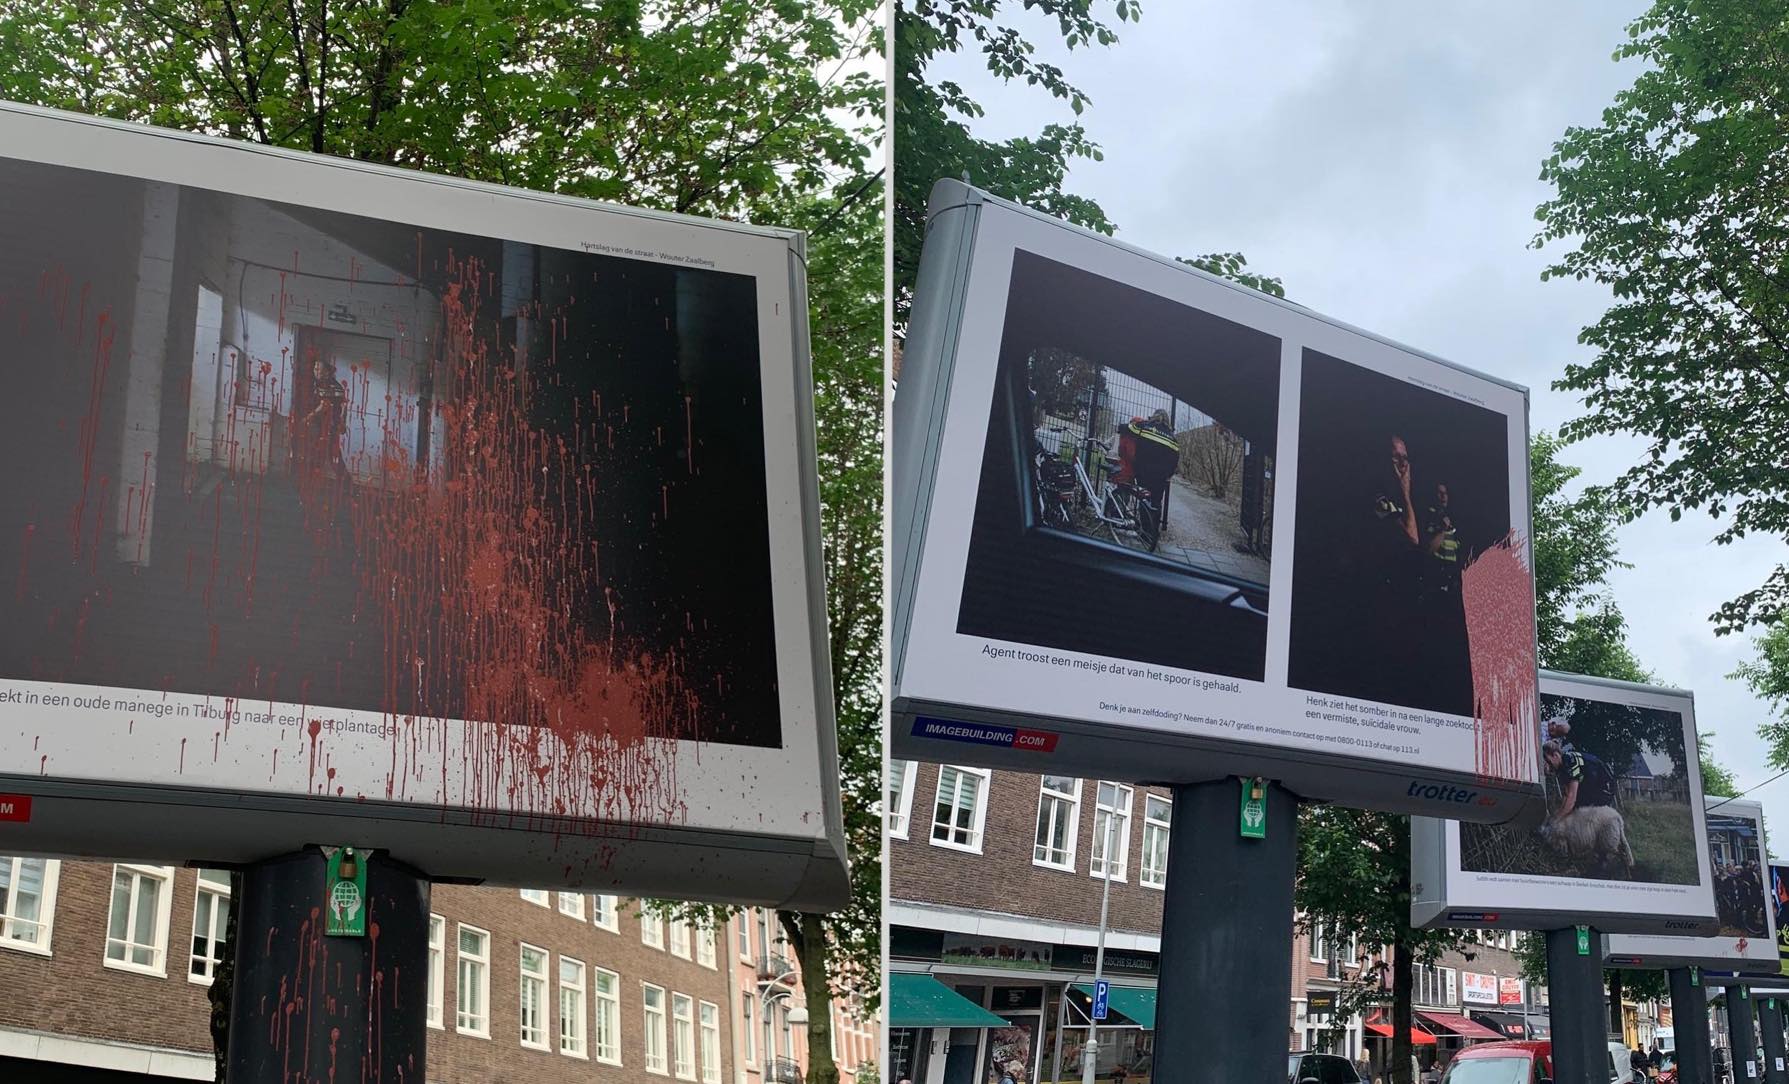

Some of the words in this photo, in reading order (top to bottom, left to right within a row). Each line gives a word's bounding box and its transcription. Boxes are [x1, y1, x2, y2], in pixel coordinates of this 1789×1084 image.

[581, 241, 610, 253] Hartslag
[624, 247, 633, 255] de
[635, 249, 654, 257] straat
[660, 252, 685, 262] Wouter
[685, 255, 715, 267] Zaalberg
[982, 644, 1016, 659] Agent
[1018, 650, 1049, 664] troost
[1051, 656, 1070, 666] een
[1073, 658, 1106, 673] meisje
[1109, 663, 1125, 675] dat
[1127, 668, 1144, 678] van
[1147, 668, 1162, 680] het
[1164, 674, 1191, 687] spoor
[1193, 676, 1201, 687] is
[1202, 679, 1242, 693] gehaald.
[0, 689, 22, 703] ekt
[25, 691, 39, 704] in
[42, 694, 69, 707] een
[73, 696, 110, 710] oude
[114, 700, 173, 718] manege
[177, 703, 189, 716] in
[193, 704, 240, 725] Tilbug
[244, 713, 276, 724] naar
[278, 715, 303, 727] een
[307, 717, 396, 739] etplantage
[1305, 709, 1321, 719] een
[1322, 712, 1360, 726] vermiste,
[1396, 723, 1421, 735] vrouw.
[1306, 695, 1328, 708] Henk
[1329, 699, 1344, 710] ziet
[1345, 701, 1358, 712] het
[1359, 704, 1388, 717] somber
[1389, 707, 1397, 718] in
[1398, 710, 1408, 720] na
[1409, 712, 1423, 722] een
[1424, 713, 1444, 727] lange
[1445, 717, 1480, 732] zoektoc
[925, 723, 1013, 743] IMAGEBUILDING
[1015, 734, 1045, 747] .COM
[1099, 701, 1118, 712] Denk
[1118, 703, 1127, 714] je
[1127, 706, 1141, 715] aan
[1142, 708, 1182, 721] zelfdoding?
[1184, 714, 1204, 724] Neem
[1205, 716, 1218, 726] dan
[1219, 718, 1236, 728] 24/7
[1236, 721, 1255, 731] gratis
[1265, 726, 1292, 736] anoniem
[1293, 730, 1315, 740] contact
[1316, 734, 1324, 742] op
[1325, 735, 1336, 743] met
[1337, 736, 1373, 748] 0800-0113
[1373, 741, 1380, 749] of
[1380, 742, 1393, 751] chat
[1393, 744, 1400, 753] op
[1407, 780, 1478, 803] trotter
[1, 803, 14, 814] M
[1082, 953, 1125, 968] ECOGISCHE
[1097, 985, 1106, 1001] P
